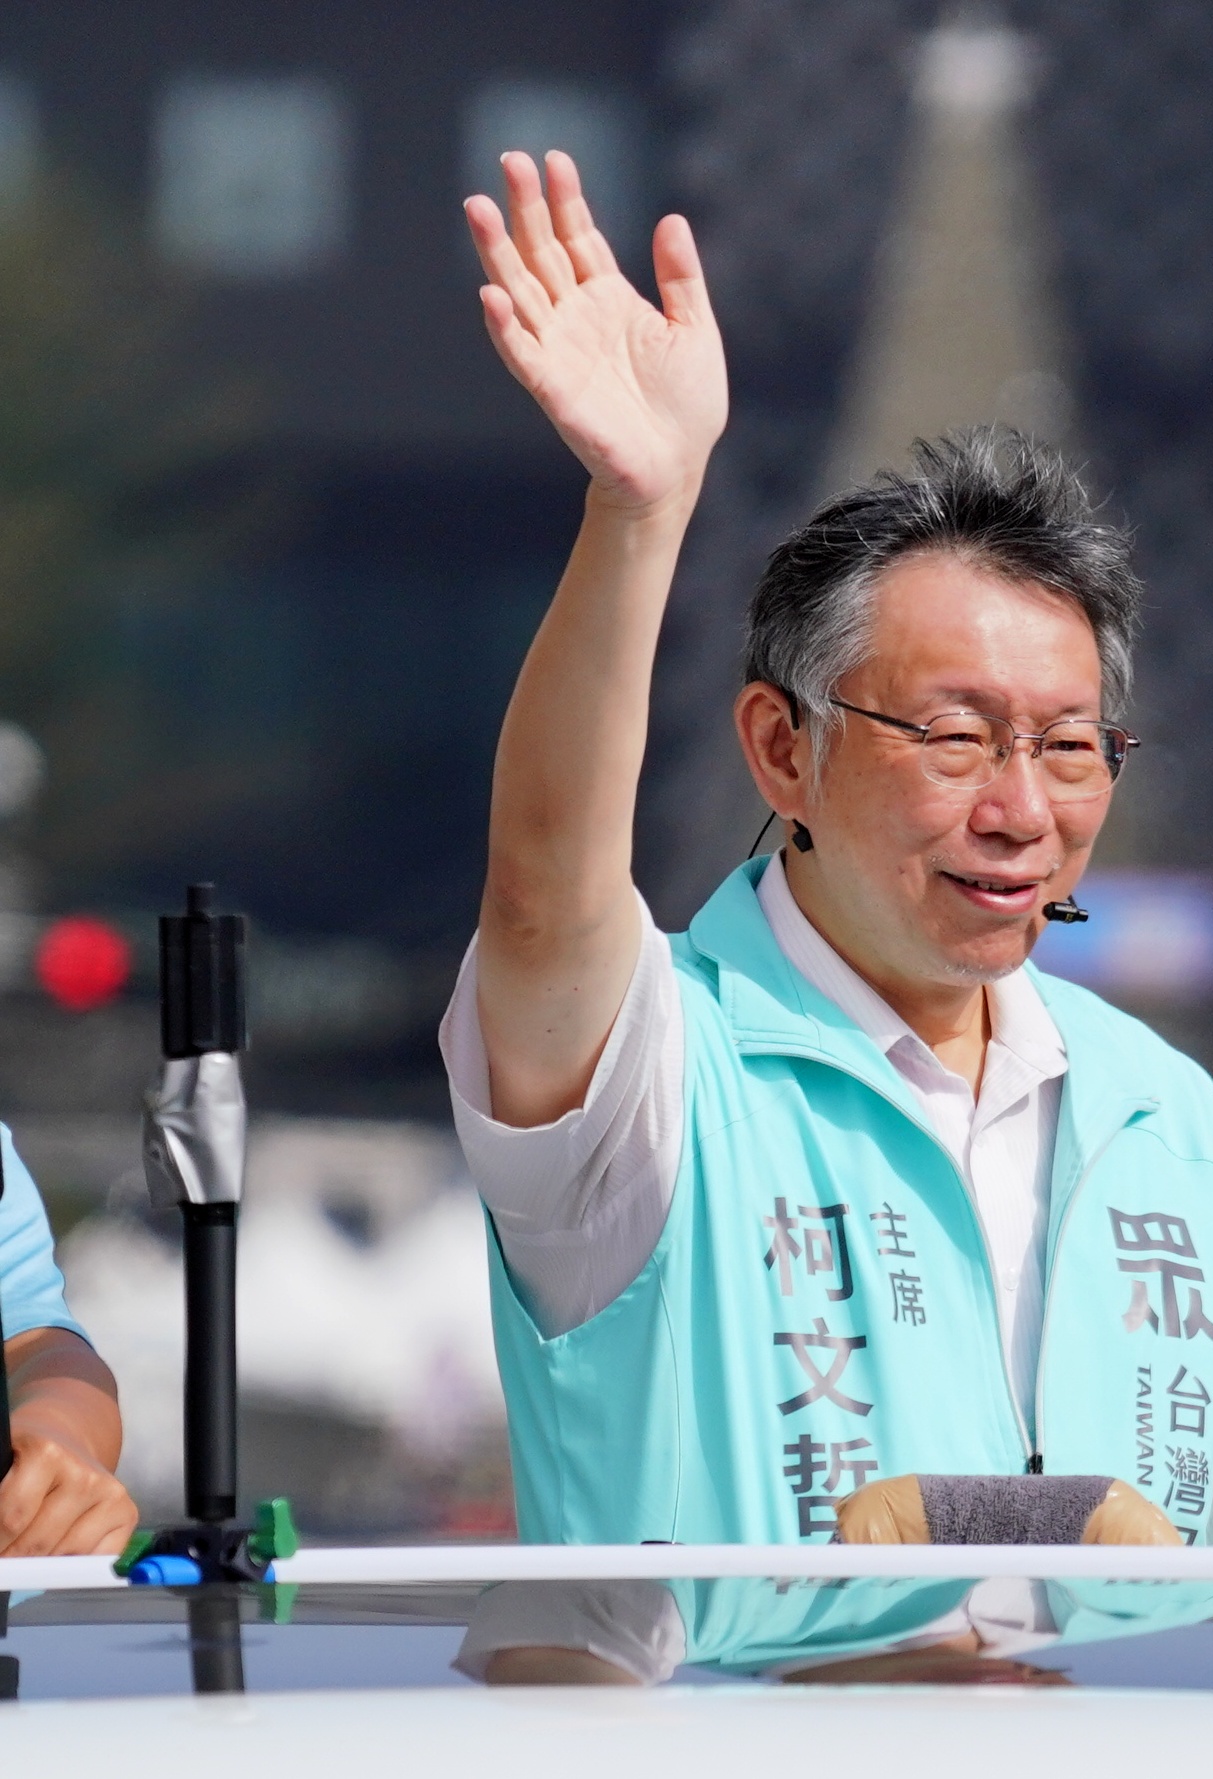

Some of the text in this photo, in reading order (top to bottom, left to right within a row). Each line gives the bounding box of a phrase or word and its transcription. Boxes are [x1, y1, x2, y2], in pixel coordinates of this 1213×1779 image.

[869, 1201, 927, 1328] 主席
[763, 1196, 879, 1538] 柯文哲
[1136, 1362, 1155, 1488] TAIWAN
